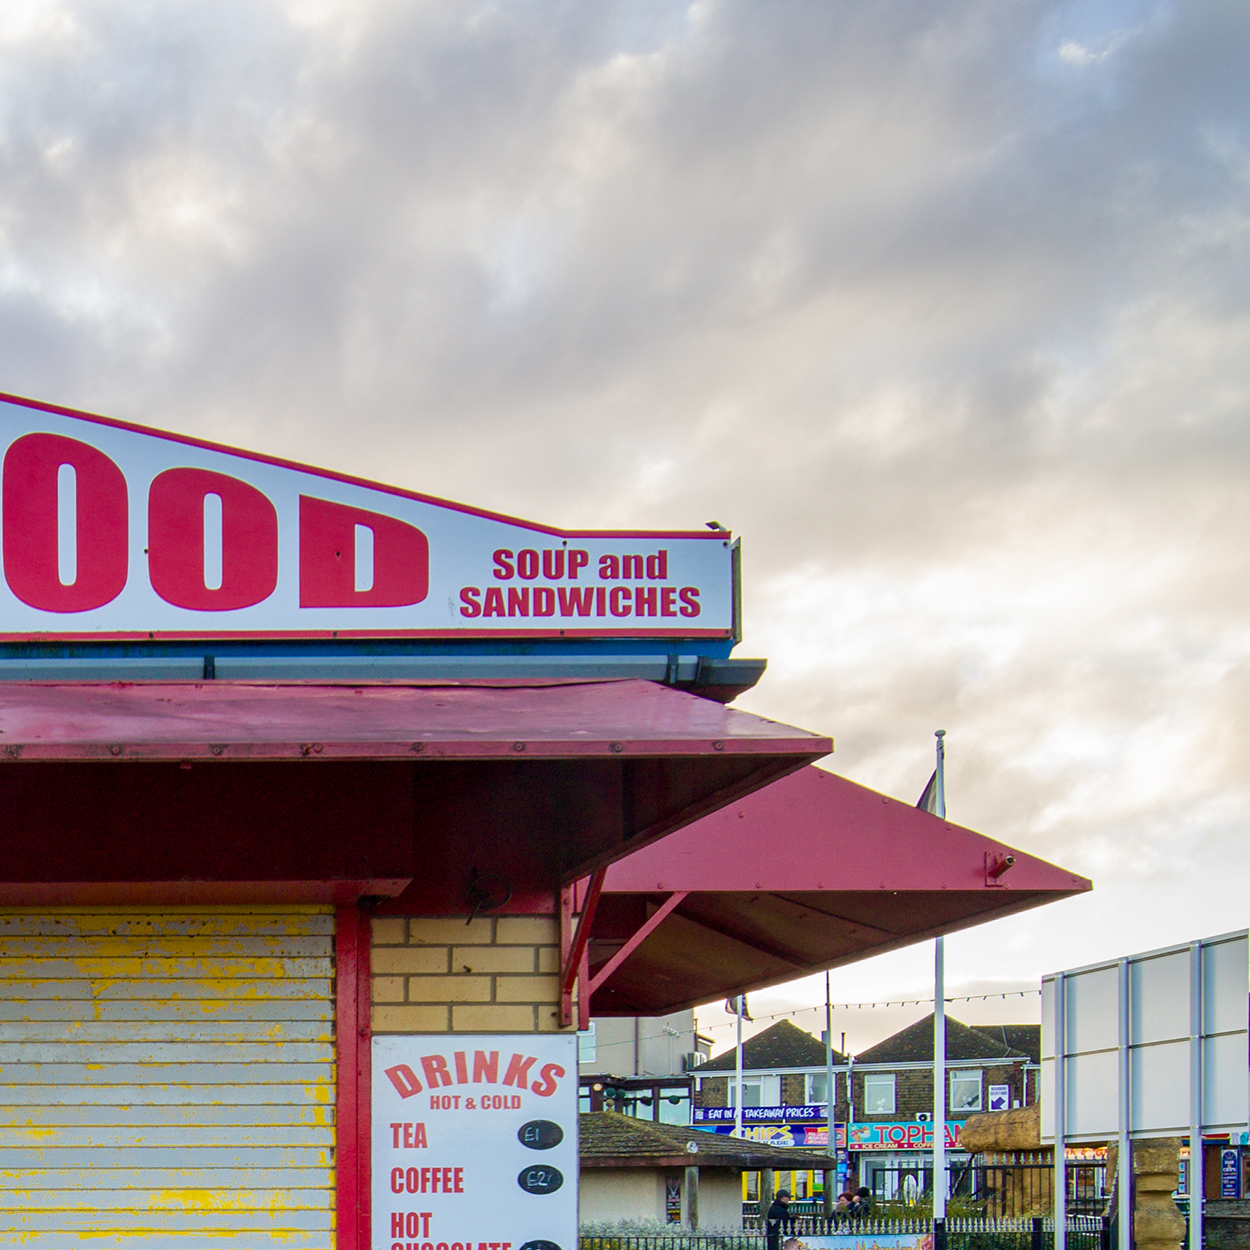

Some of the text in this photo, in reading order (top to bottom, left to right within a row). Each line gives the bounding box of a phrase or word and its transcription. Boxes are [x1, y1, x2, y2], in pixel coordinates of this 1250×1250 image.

[492, 548, 668, 581] SOUP and
[459, 585, 702, 620] SANDWICHES
[384, 1050, 566, 1100] DRINKS
[430, 1095, 522, 1110] HOT & COLD
[708, 1109, 723, 1119] EAT
[724, 1108, 733, 1119] IN
[744, 1107, 785, 1118] TAKEAWAY
[786, 1107, 814, 1118] PRICES
[390, 1122, 428, 1149] TEA
[390, 1167, 464, 1194] COFFEE
[390, 1212, 433, 1239] HOT
